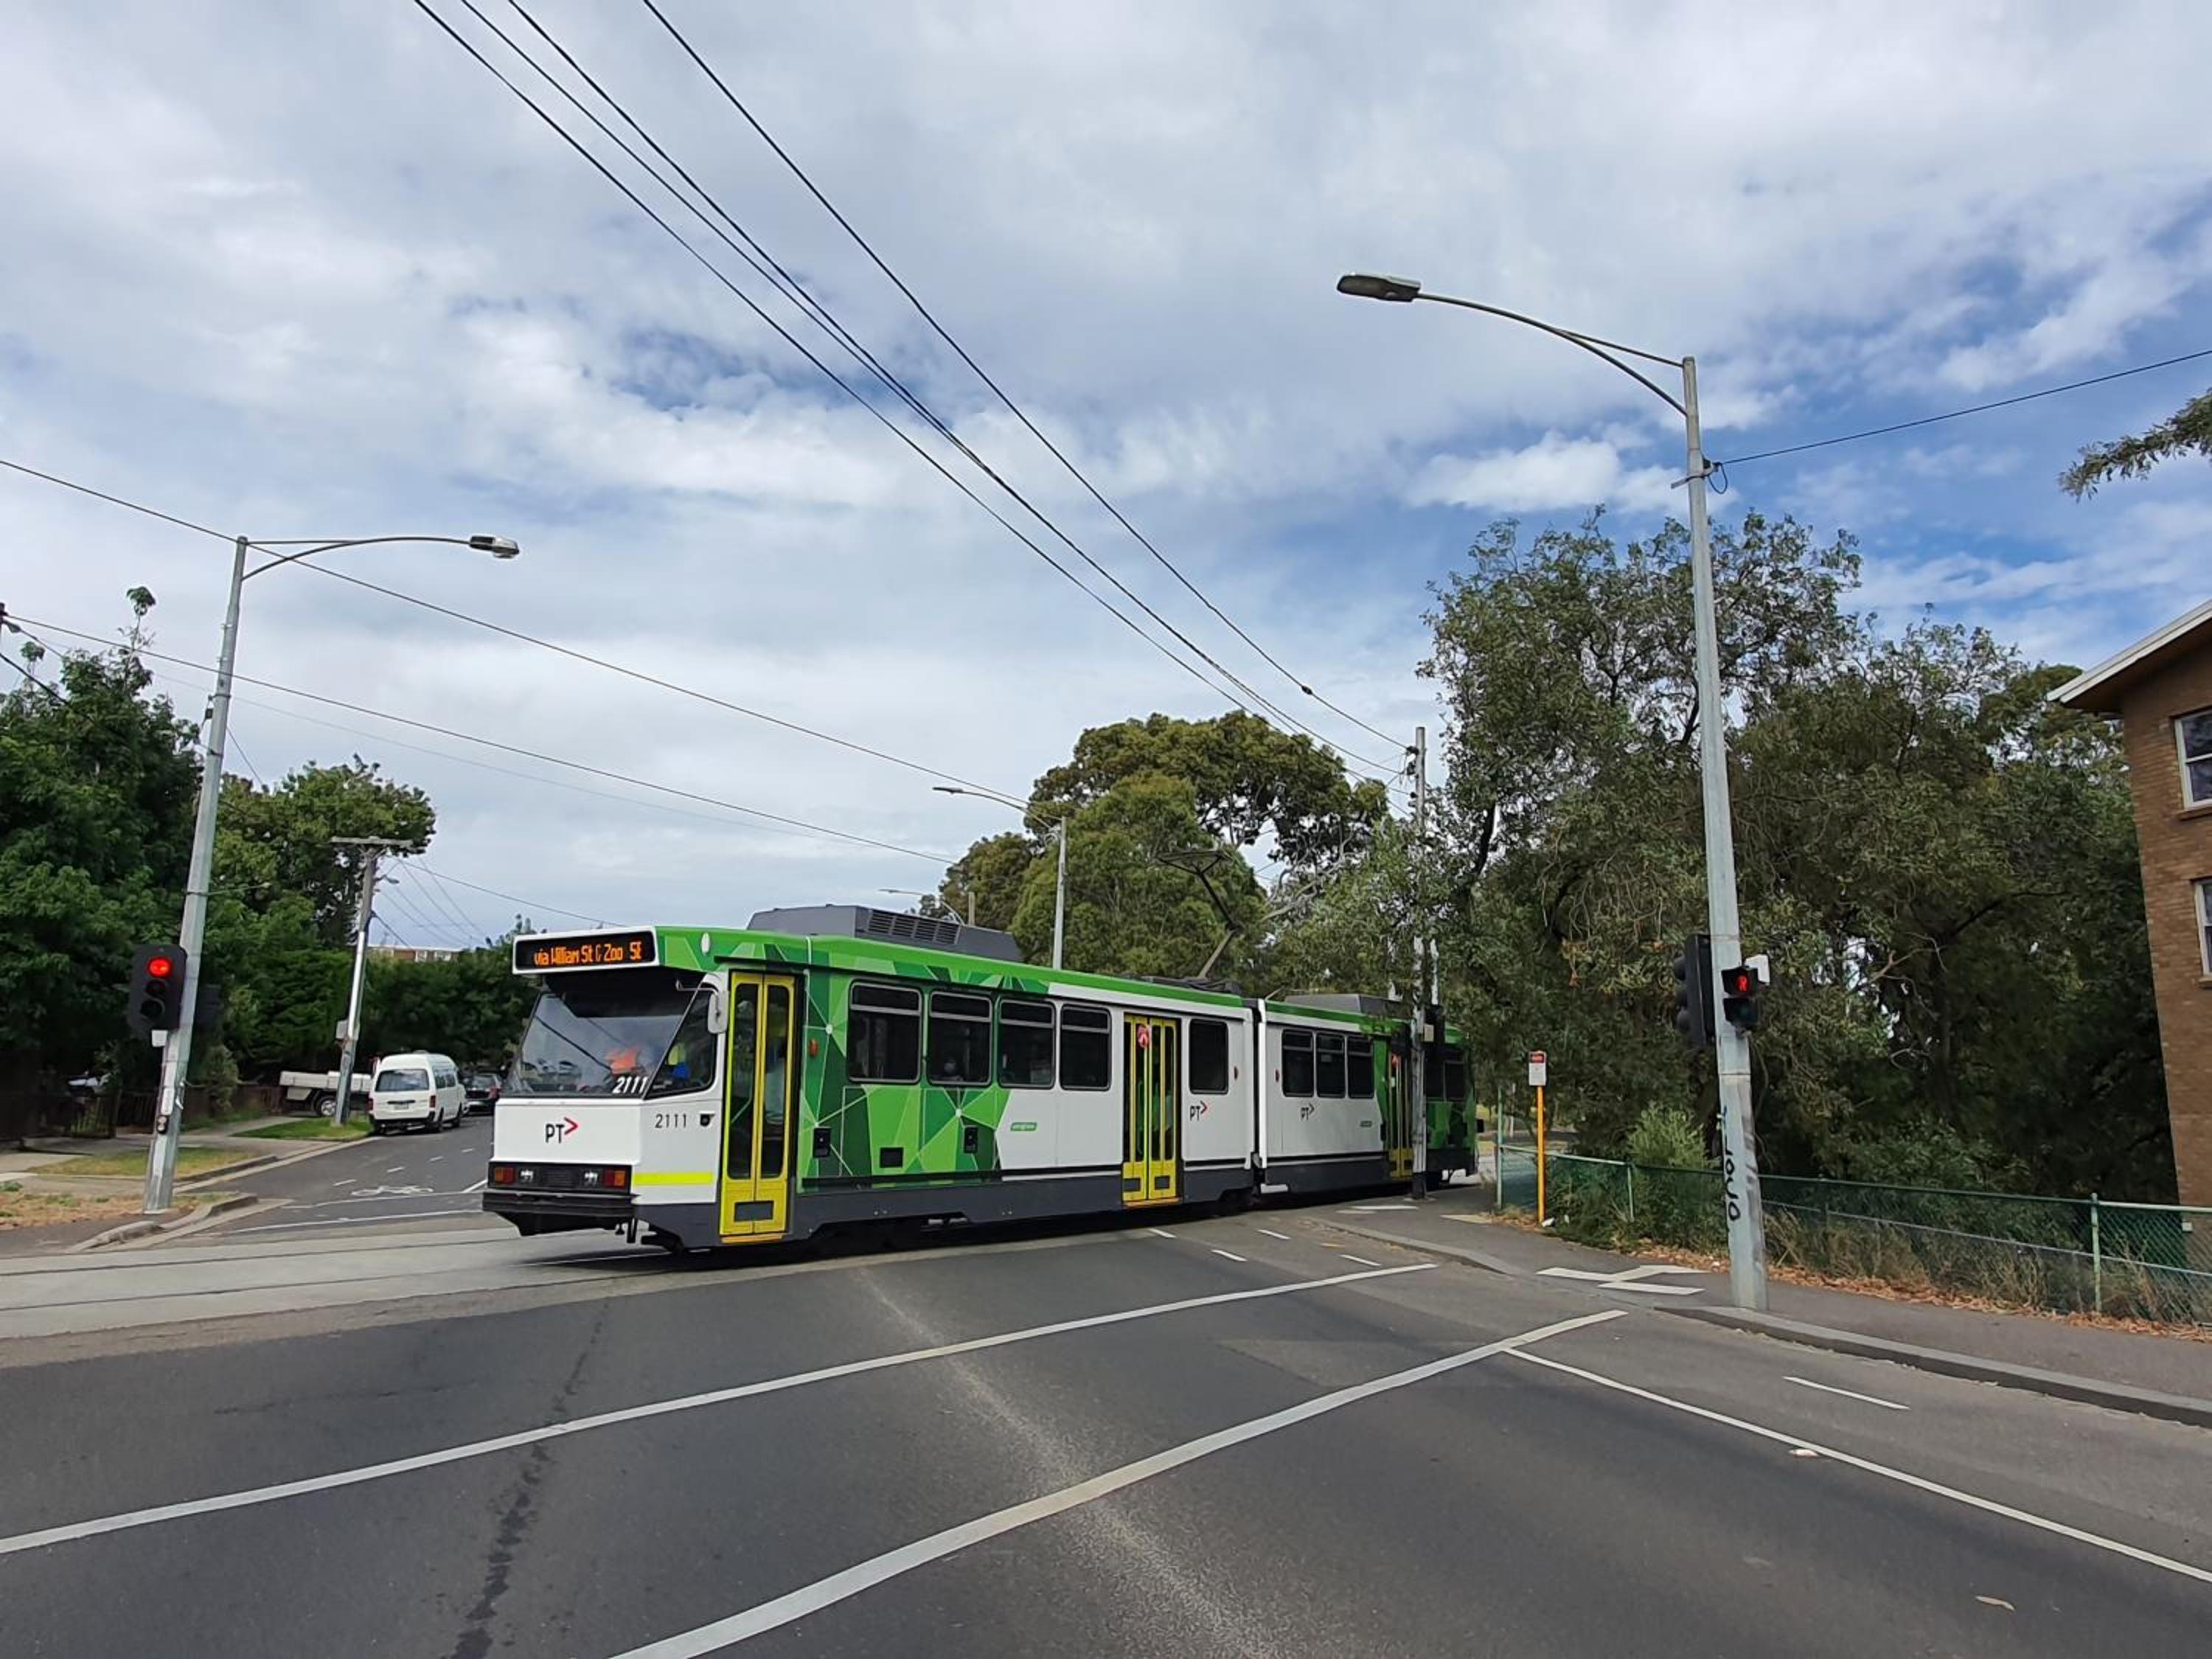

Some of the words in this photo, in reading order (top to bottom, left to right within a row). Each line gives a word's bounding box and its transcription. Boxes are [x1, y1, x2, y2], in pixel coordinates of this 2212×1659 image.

[534, 949, 549, 966] via
[604, 943, 623, 962] Zoo
[612, 1076, 648, 1094] 2111
[655, 1113, 687, 1129] 2111
